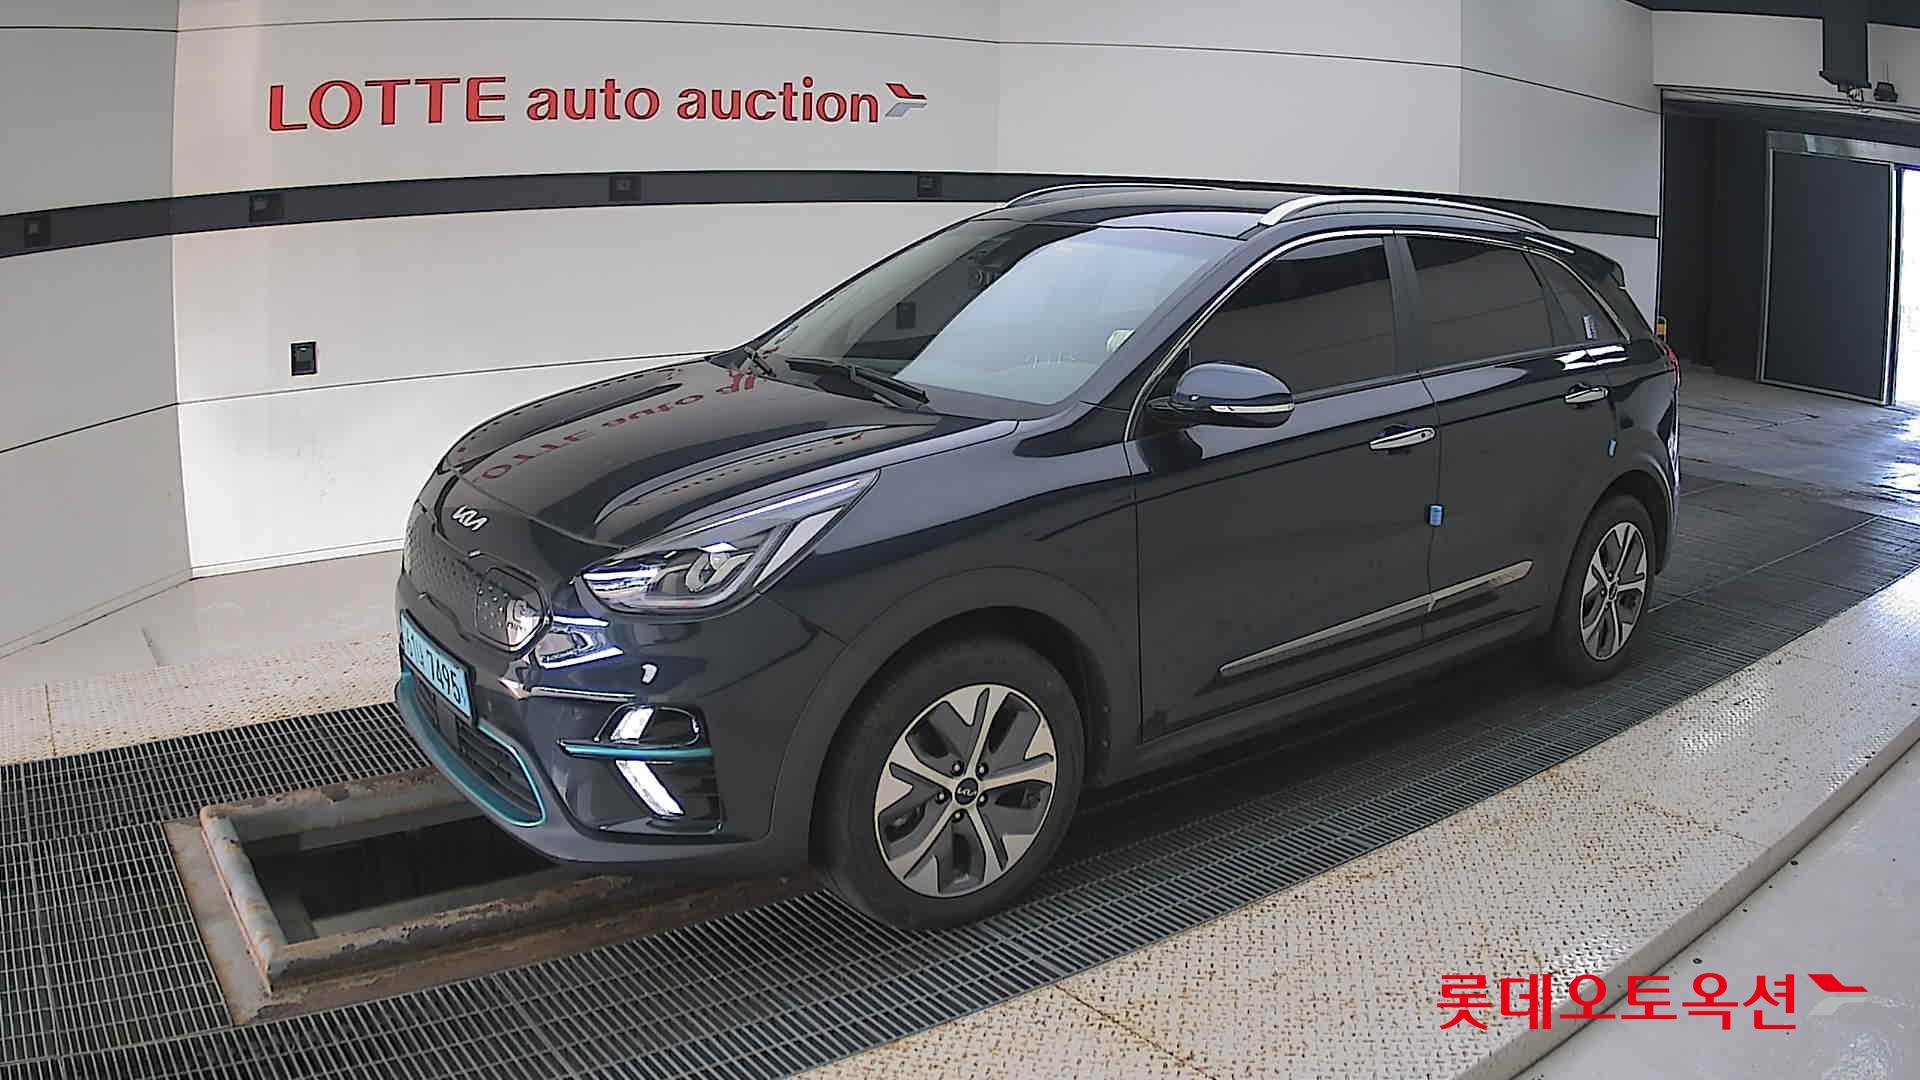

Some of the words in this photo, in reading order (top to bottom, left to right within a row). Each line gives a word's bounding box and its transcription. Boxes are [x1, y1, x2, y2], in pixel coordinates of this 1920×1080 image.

[268, 76, 507, 132] LOTTE
[526, 78, 661, 122] auto
[676, 75, 880, 124] auction
[425, 649, 462, 704] 7495
